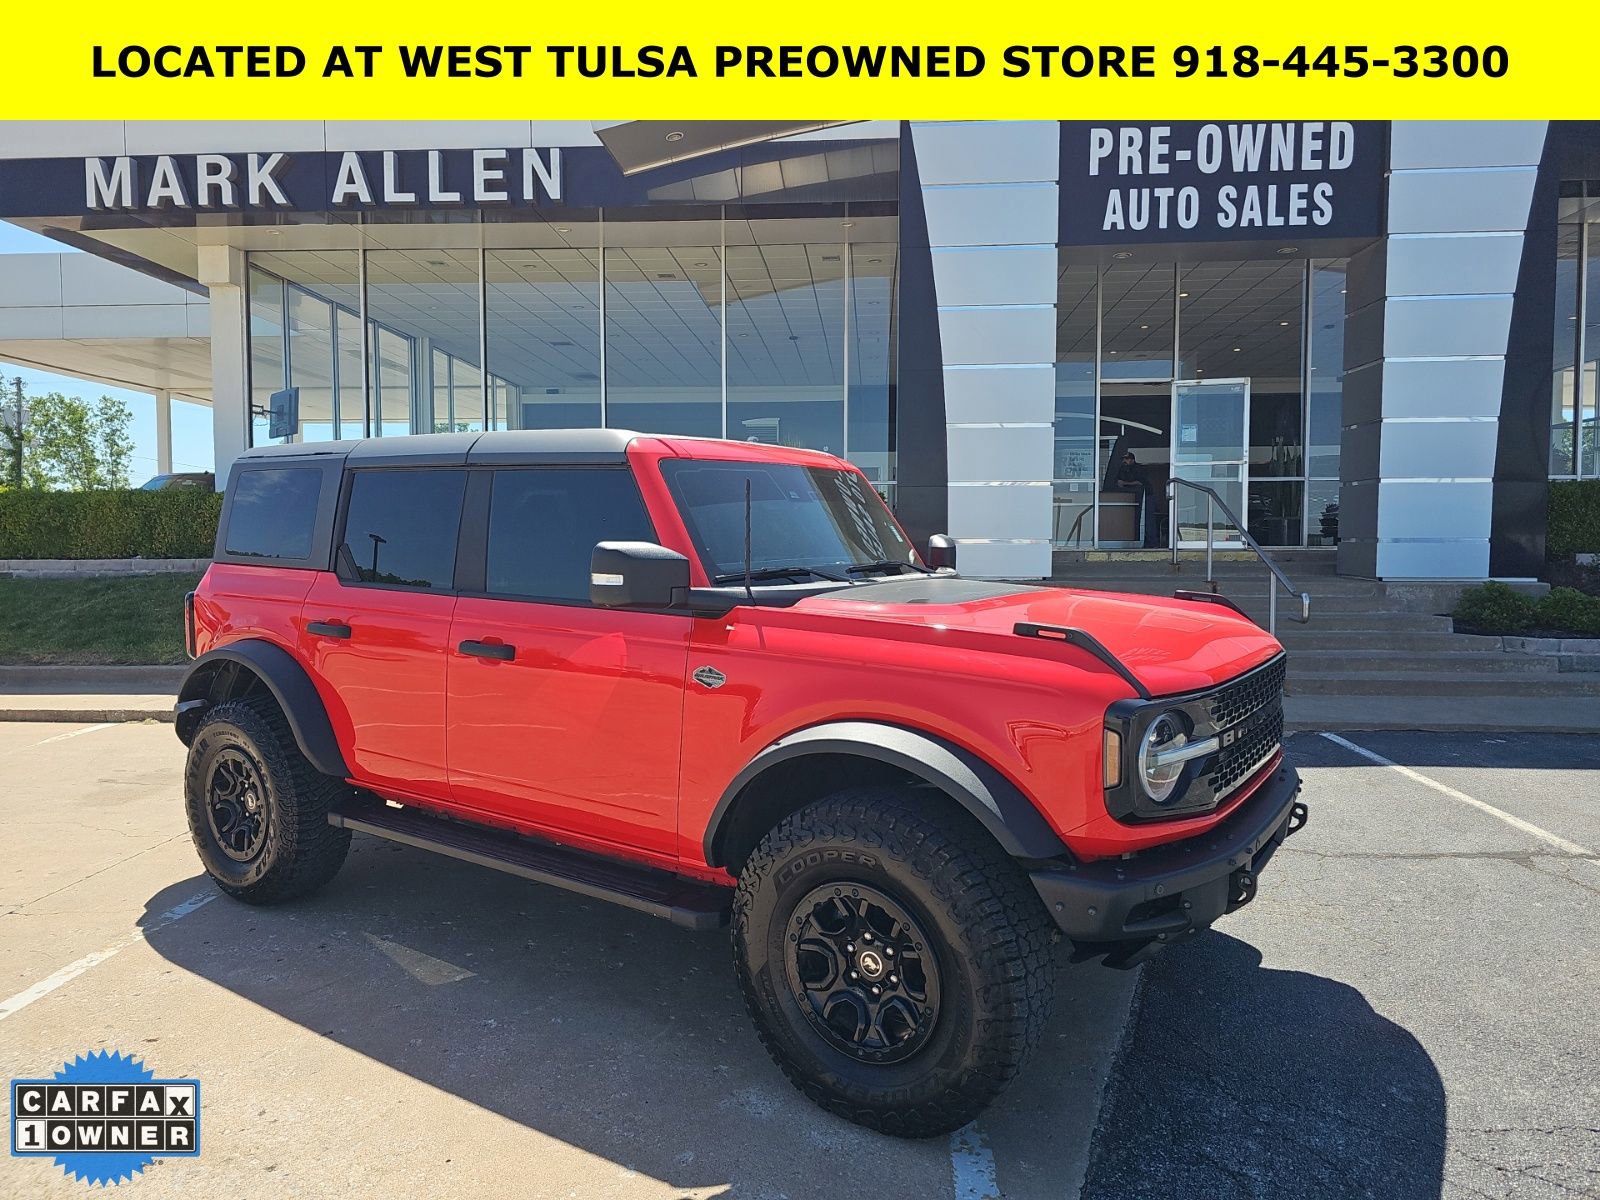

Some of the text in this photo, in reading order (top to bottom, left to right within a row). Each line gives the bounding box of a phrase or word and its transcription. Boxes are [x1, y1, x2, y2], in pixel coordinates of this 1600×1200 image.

[1089, 121, 1355, 176] PRE-OWNED
[85, 148, 563, 208] MARK ALLEN
[1102, 182, 1334, 231] AUTO SALES
[779, 852, 877, 884] COOPER
